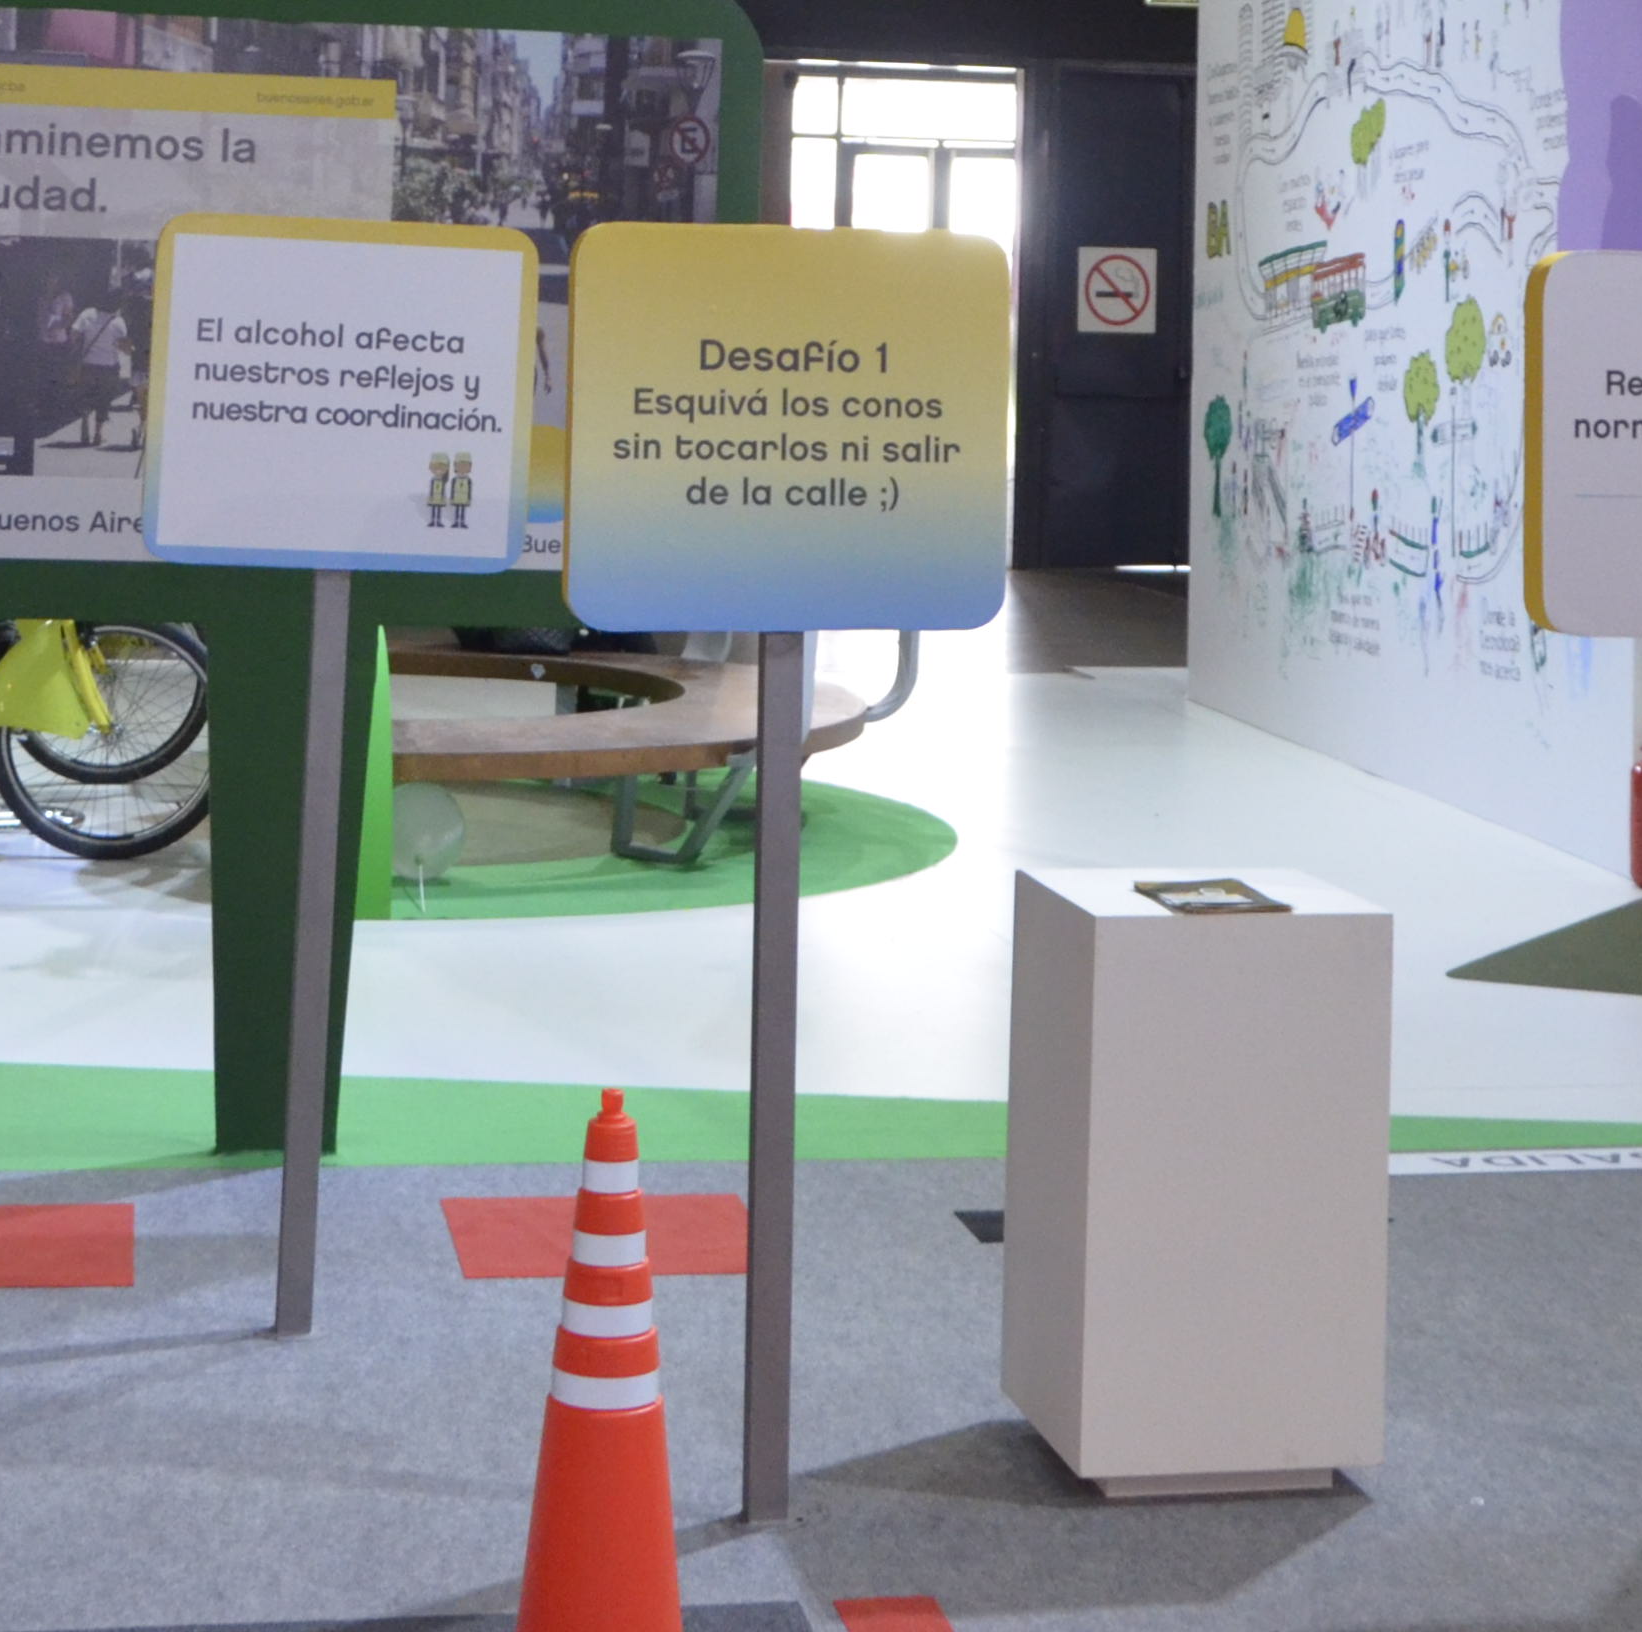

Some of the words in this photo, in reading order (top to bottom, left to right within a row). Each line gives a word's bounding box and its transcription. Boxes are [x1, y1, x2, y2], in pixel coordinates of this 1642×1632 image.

[221, 127, 256, 164] la
[196, 317, 223, 343] El
[234, 319, 344, 348] alcohol
[355, 327, 465, 354] afecta
[699, 338, 860, 374] Desafío
[876, 342, 887, 374] 1
[194, 361, 330, 387] nuestros
[339, 364, 454, 398] reflejos
[464, 375, 480, 401] y
[192, 400, 308, 424] nuestra
[315, 397, 502, 433] coordinación.
[633, 387, 768, 422] Esquivá
[782, 387, 830, 418] los
[841, 396, 943, 419] conos
[613, 432, 661, 460] sin
[675, 432, 828, 462] tocarlos
[841, 435, 869, 462] ni
[882, 437, 961, 463] salir
[685, 476, 729, 506] de
[742, 476, 772, 506] la
[785, 477, 868, 507] calle
[880, 481, 899, 513] ;)
[89, 510, 143, 534] Air
